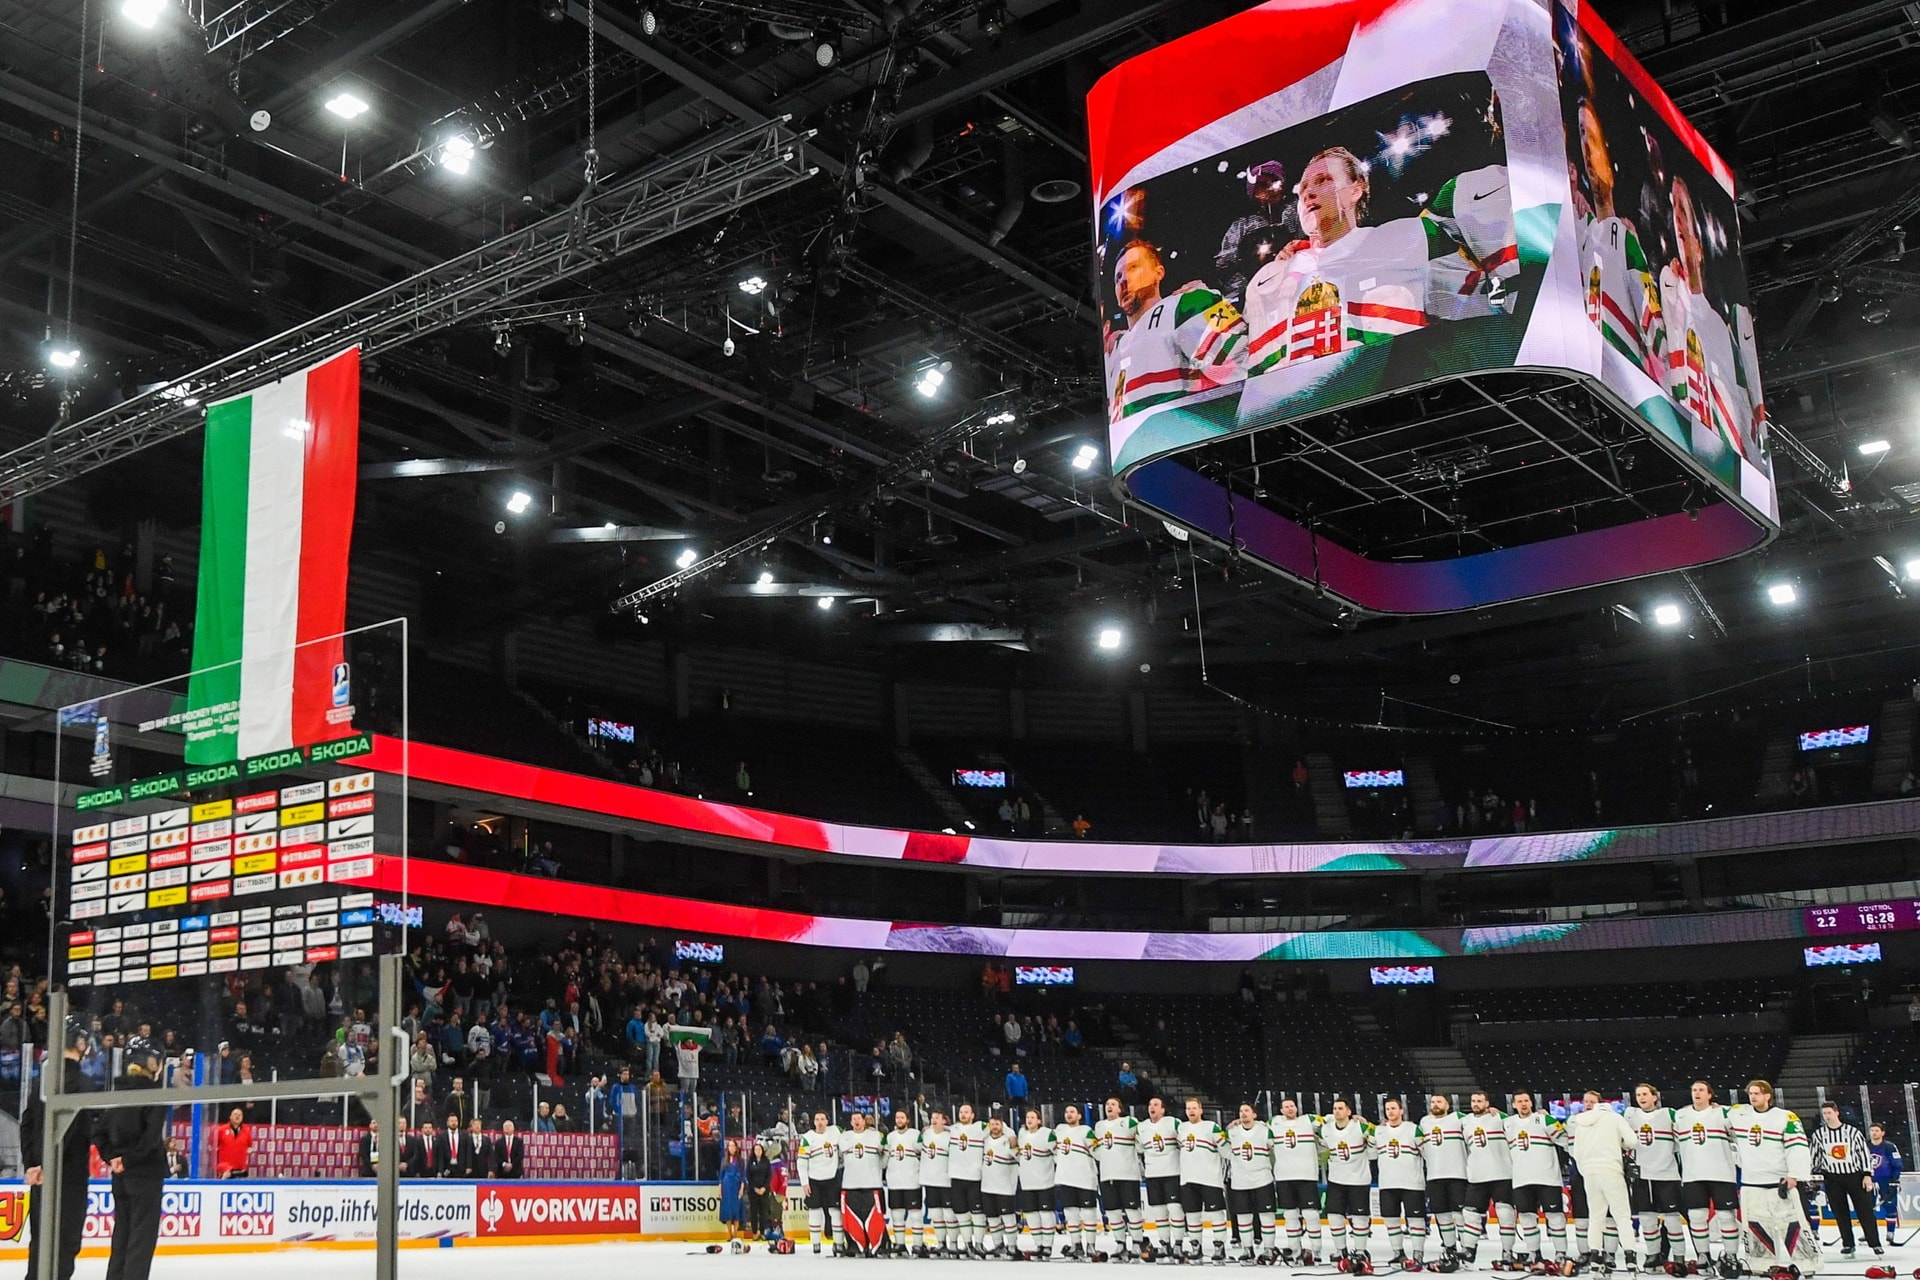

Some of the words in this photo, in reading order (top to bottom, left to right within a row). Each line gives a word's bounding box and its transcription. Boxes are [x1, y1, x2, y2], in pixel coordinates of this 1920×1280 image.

[1148, 304, 1164, 330] A
[1858, 904, 1892, 912] CONTROL
[1859, 912, 1895, 925] 16:28
[1816, 916, 1837, 928] 2.2
[160, 1192, 200, 1214] QUI
[221, 1192, 274, 1213] LIQUI
[288, 1199, 471, 1228] shop.iihfrlds.com
[510, 1198, 638, 1223] WORKWEAR
[160, 1214, 200, 1237] OLY
[221, 1214, 273, 1236] MOLY
